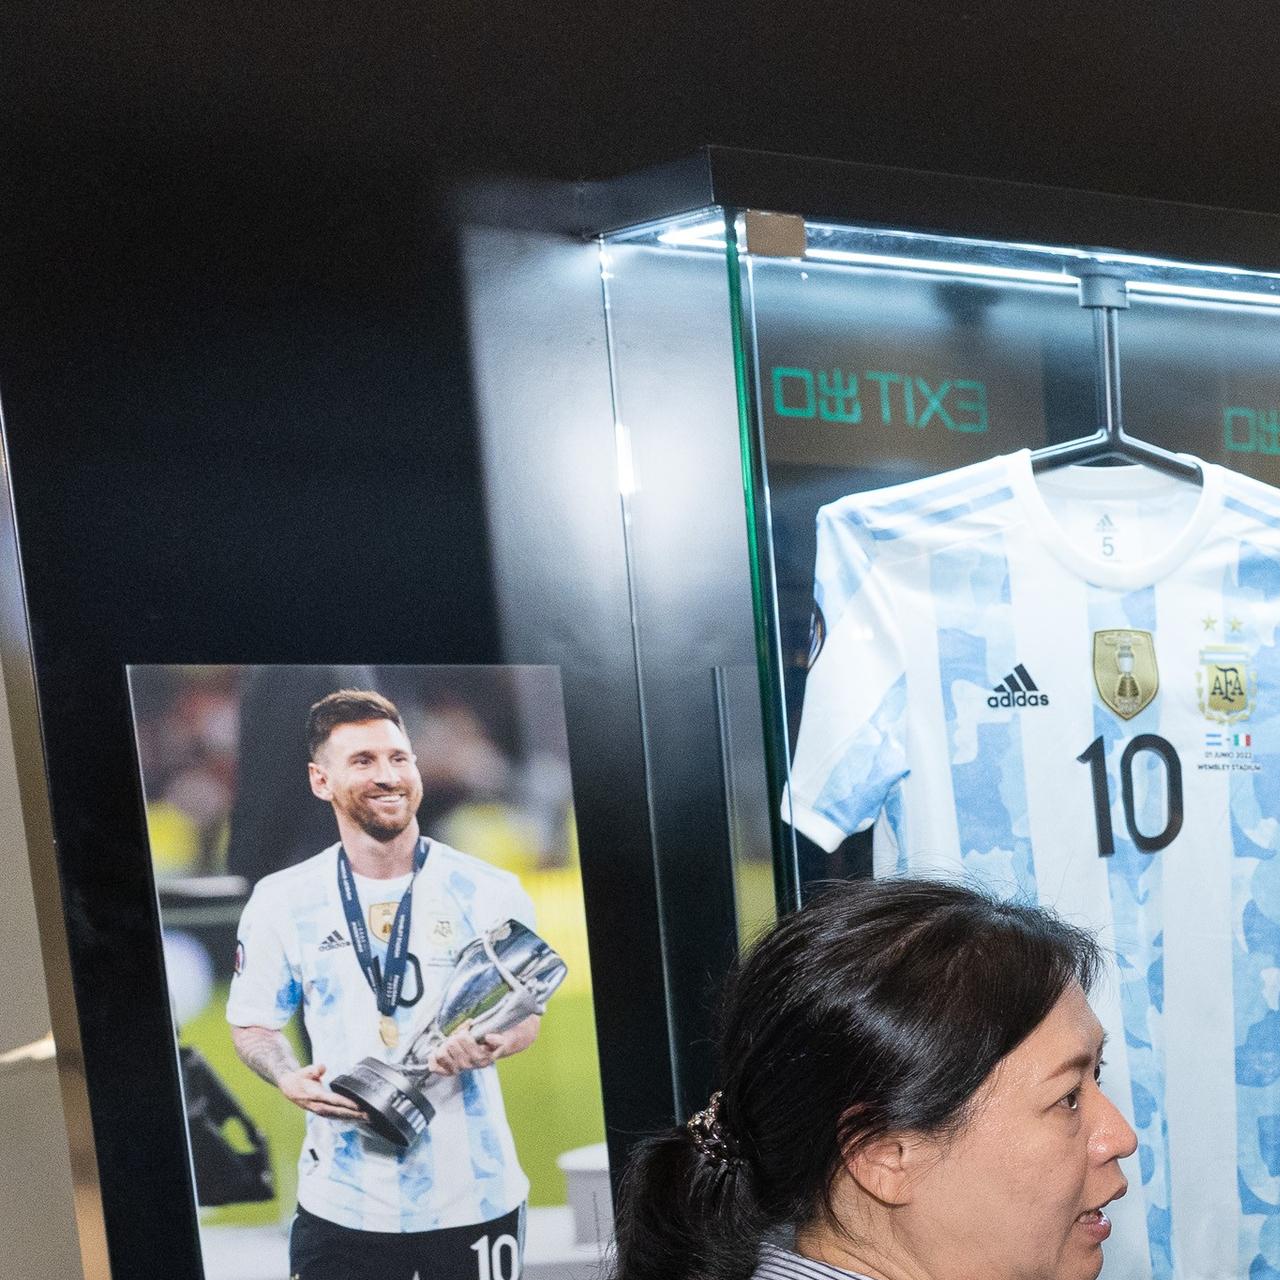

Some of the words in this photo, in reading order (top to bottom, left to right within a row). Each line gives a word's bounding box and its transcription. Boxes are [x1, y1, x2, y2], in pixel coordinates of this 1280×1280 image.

[1102, 536, 1114, 557] 5
[987, 690, 1050, 709] adidas
[1076, 734, 1184, 858] 10
